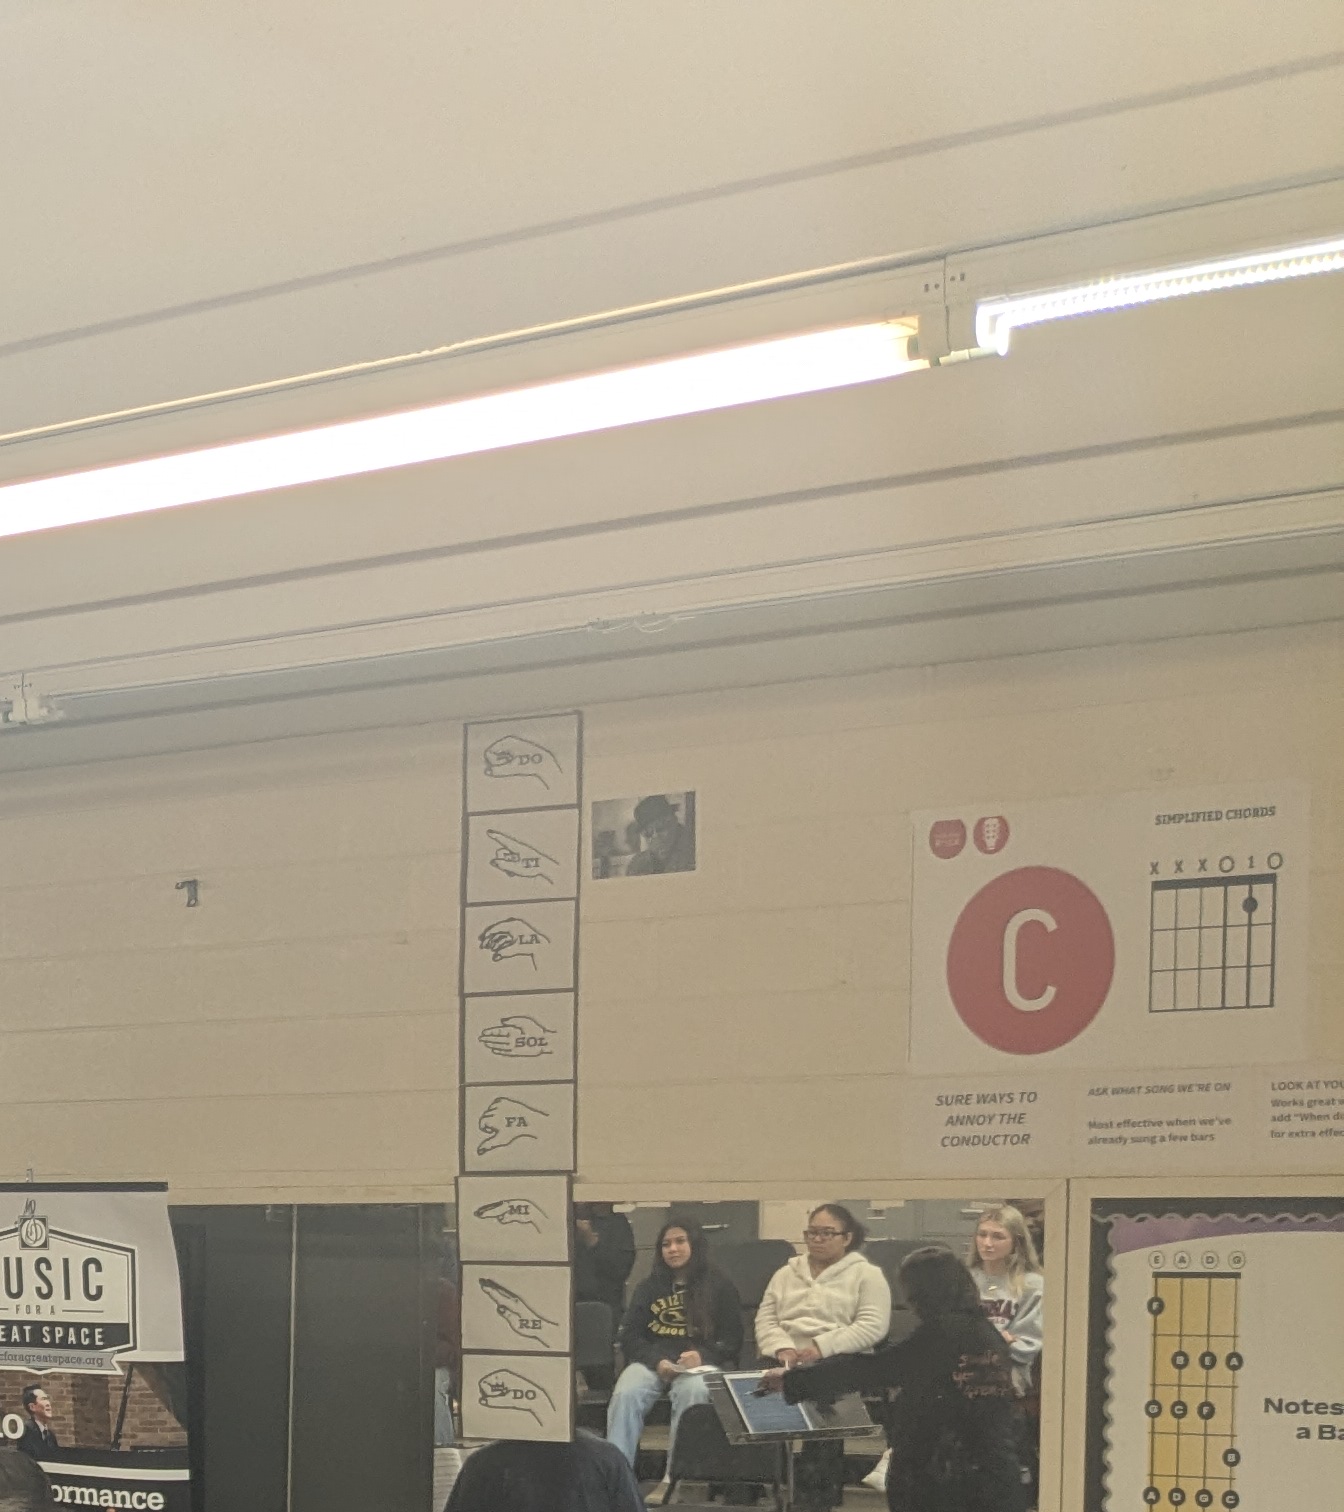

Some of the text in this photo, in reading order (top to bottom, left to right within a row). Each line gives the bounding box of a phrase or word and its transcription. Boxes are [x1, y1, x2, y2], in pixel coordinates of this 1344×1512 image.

[518, 753, 543, 765] DO
[1155, 805, 1276, 826] SIMPLIFIED CHORDS
[522, 857, 540, 869] TI
[518, 933, 541, 946] LA
[1002, 908, 1058, 1013] C
[515, 1036, 548, 1048] SOL
[1111, 1084, 1142, 1096] WHAT
[1144, 1083, 1175, 1095] SONG
[1214, 1081, 1231, 1092] ON
[1271, 1080, 1304, 1091] LOOK
[1305, 1080, 1320, 1090] AT
[935, 1091, 1038, 1107] SURE WAYS TO
[1271, 1098, 1304, 1107] Works
[1306, 1097, 1336, 1109] great
[505, 1115, 528, 1128] FA
[945, 1112, 1027, 1127] ANNOY THE
[1088, 1118, 1114, 1130] Most
[1116, 1117, 1163, 1129] effective
[1166, 1117, 1196, 1128] when
[1271, 1113, 1292, 1122] add
[940, 1133, 1031, 1147] CONDUCTOR
[1088, 1134, 1127, 1147] already
[1168, 1132, 1189, 1143] few
[1191, 1131, 1216, 1142] bars
[1288, 1129, 1316, 1138] extra
[508, 1204, 530, 1216] MI
[15, 1304, 56, 1316] FOR A
[518, 1318, 542, 1330] RE
[42, 1325, 104, 1346] SPACE
[512, 1388, 537, 1401] DO
[1264, 1398, 1344, 1415] Notes
[1295, 1424, 1344, 1440] a Ba
[51, 1484, 164, 1511] ormance
